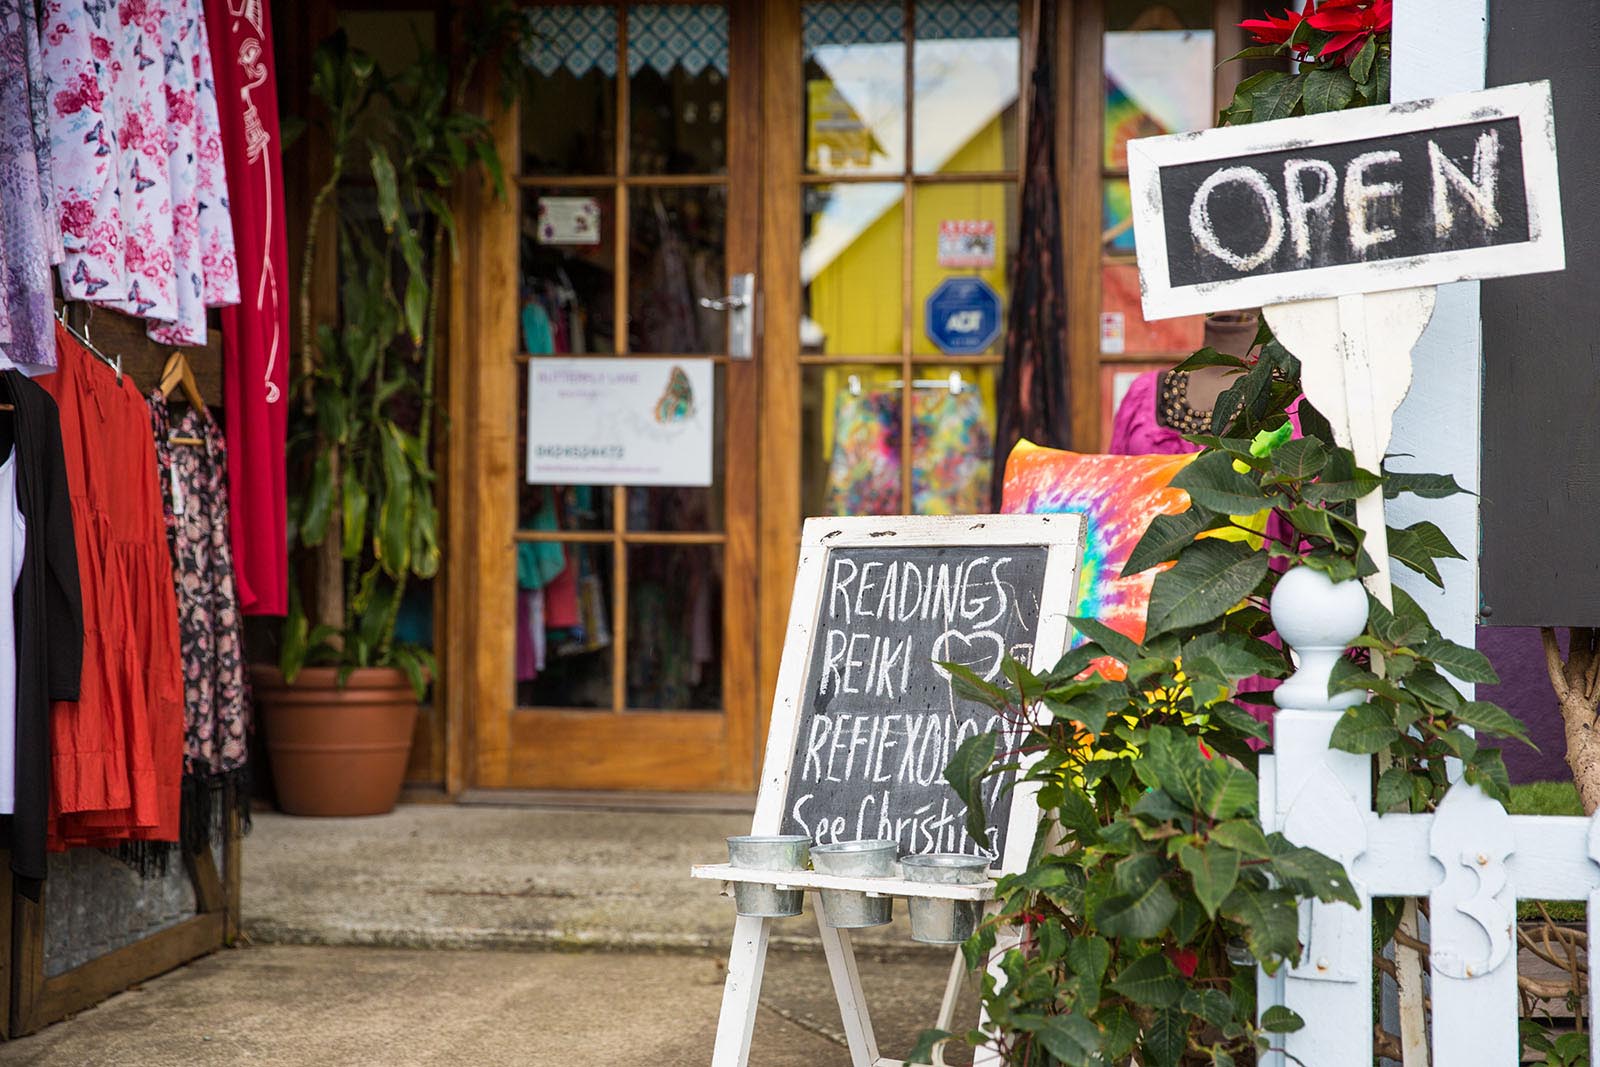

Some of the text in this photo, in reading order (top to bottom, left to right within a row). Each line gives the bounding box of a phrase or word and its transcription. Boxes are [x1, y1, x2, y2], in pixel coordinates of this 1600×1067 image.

[1189, 128, 1503, 271] OPEN
[828, 555, 1012, 630] READINGS
[819, 629, 913, 699] REIKI
[793, 793, 846, 846] See
[1430, 850, 1513, 980] 3
